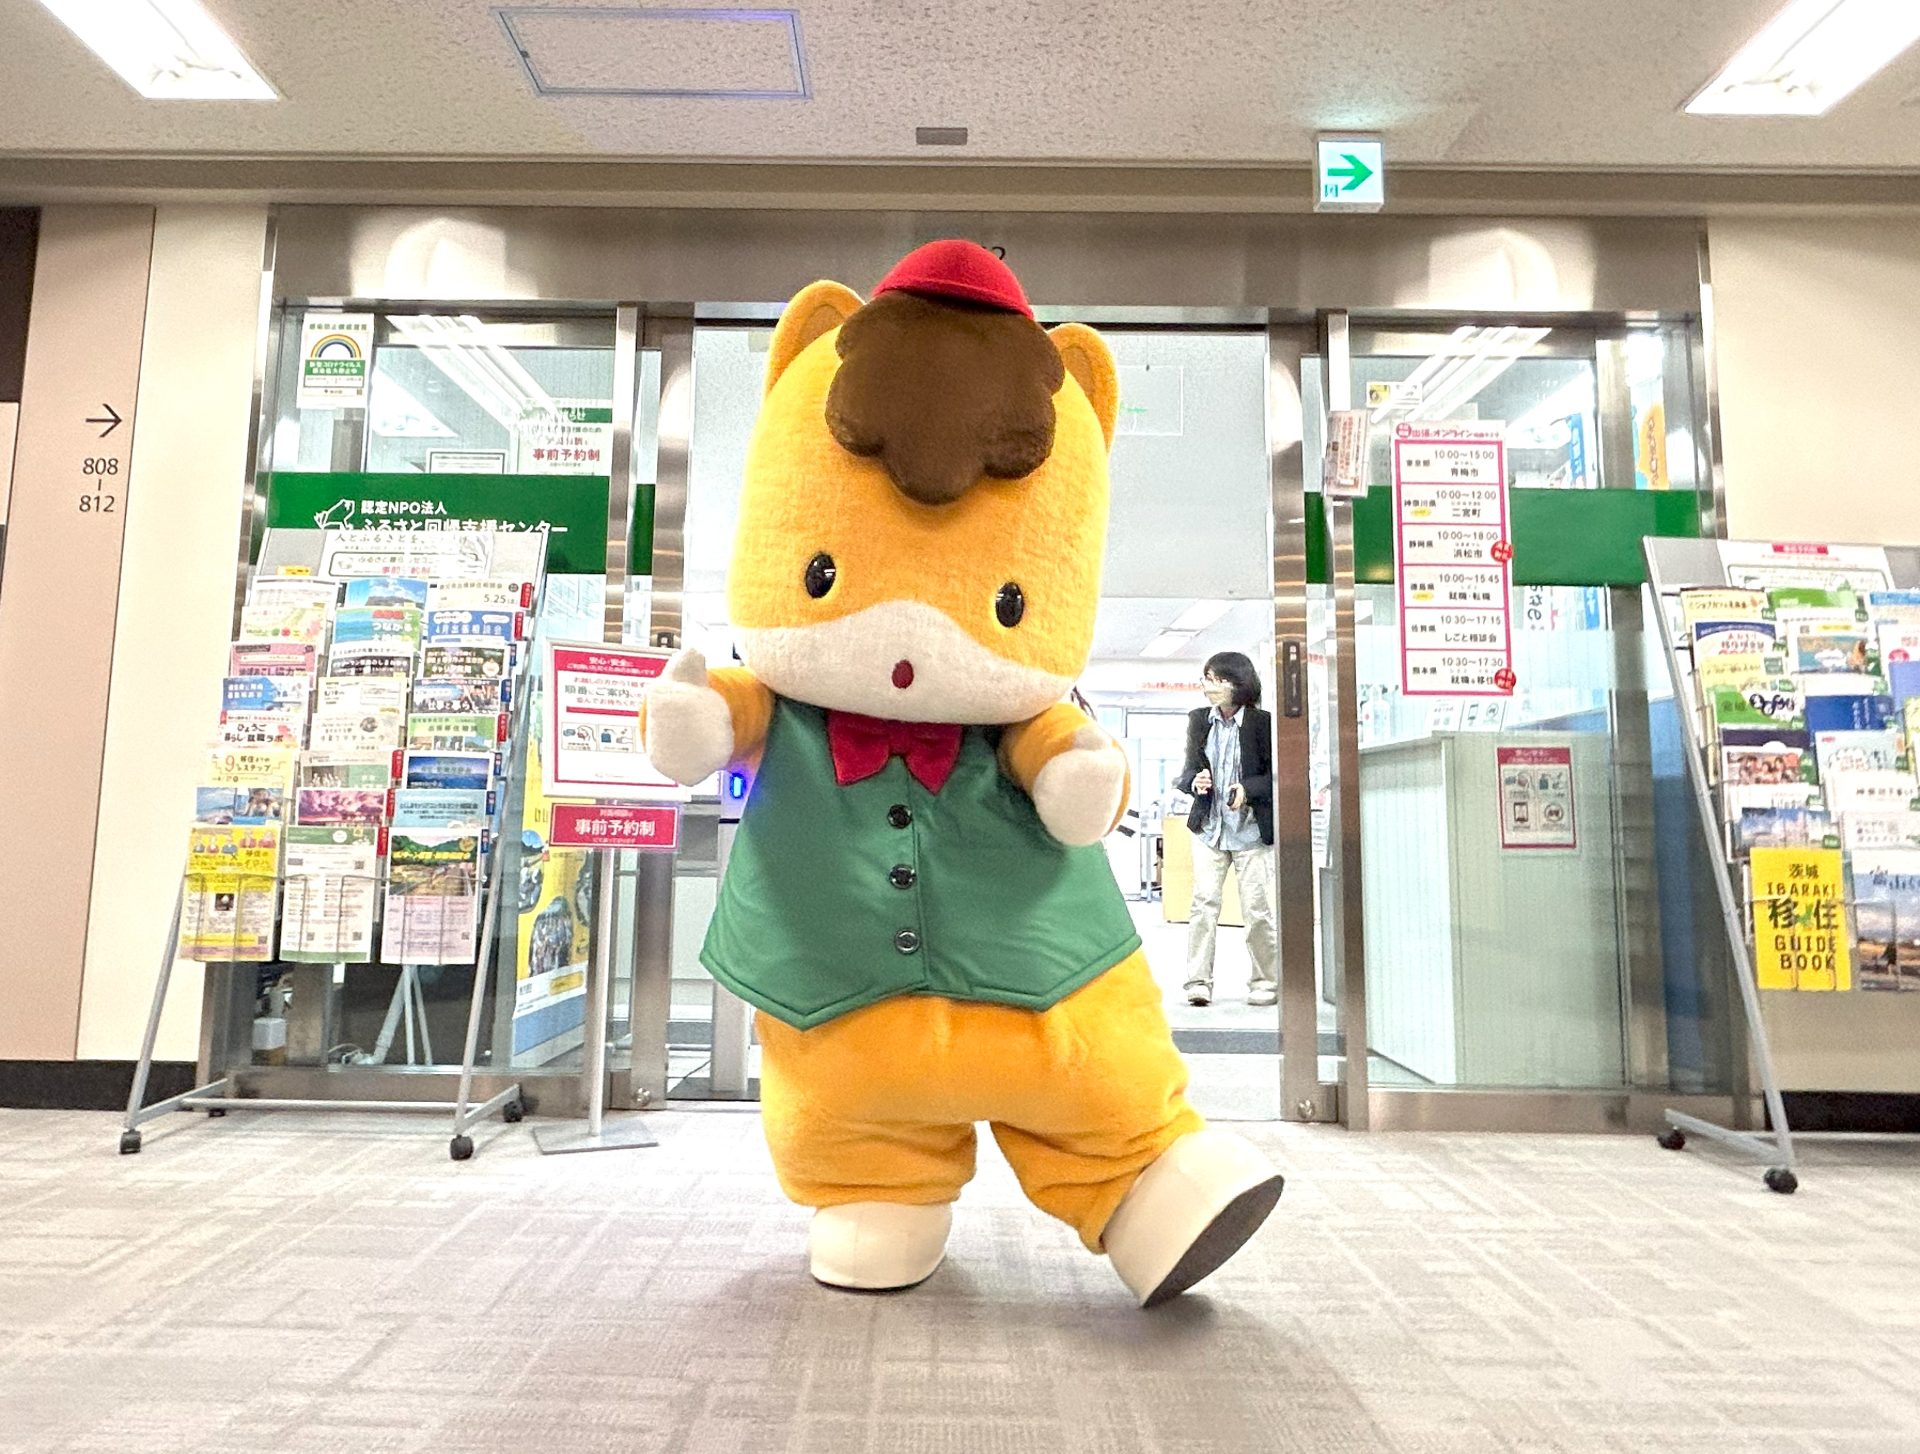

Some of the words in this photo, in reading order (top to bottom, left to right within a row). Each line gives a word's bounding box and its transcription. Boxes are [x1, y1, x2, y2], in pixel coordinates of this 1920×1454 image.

[532, 448, 600, 461] 事前予約制
[82, 457, 119, 475] 808
[79, 494, 115, 512] 812
[361, 500, 447, 515] 認定NPO法人
[1404, 499, 1437, 508] 神奈川県
[1452, 508, 1481, 518] 二宮町
[1409, 540, 1434, 548] 静岡県
[1454, 549, 1483, 558] 浜松市
[1412, 666, 1437, 674] 熊本県
[238, 723, 267, 733] ひょうご
[574, 818, 656, 837] 事前予約制
[1788, 863, 1819, 879] 茨城
[1767, 882, 1836, 898] IBARAKI
[1767, 897, 1839, 930] 移住
[1775, 934, 1836, 952] GUIDE
[1780, 953, 1835, 970] BOOK
